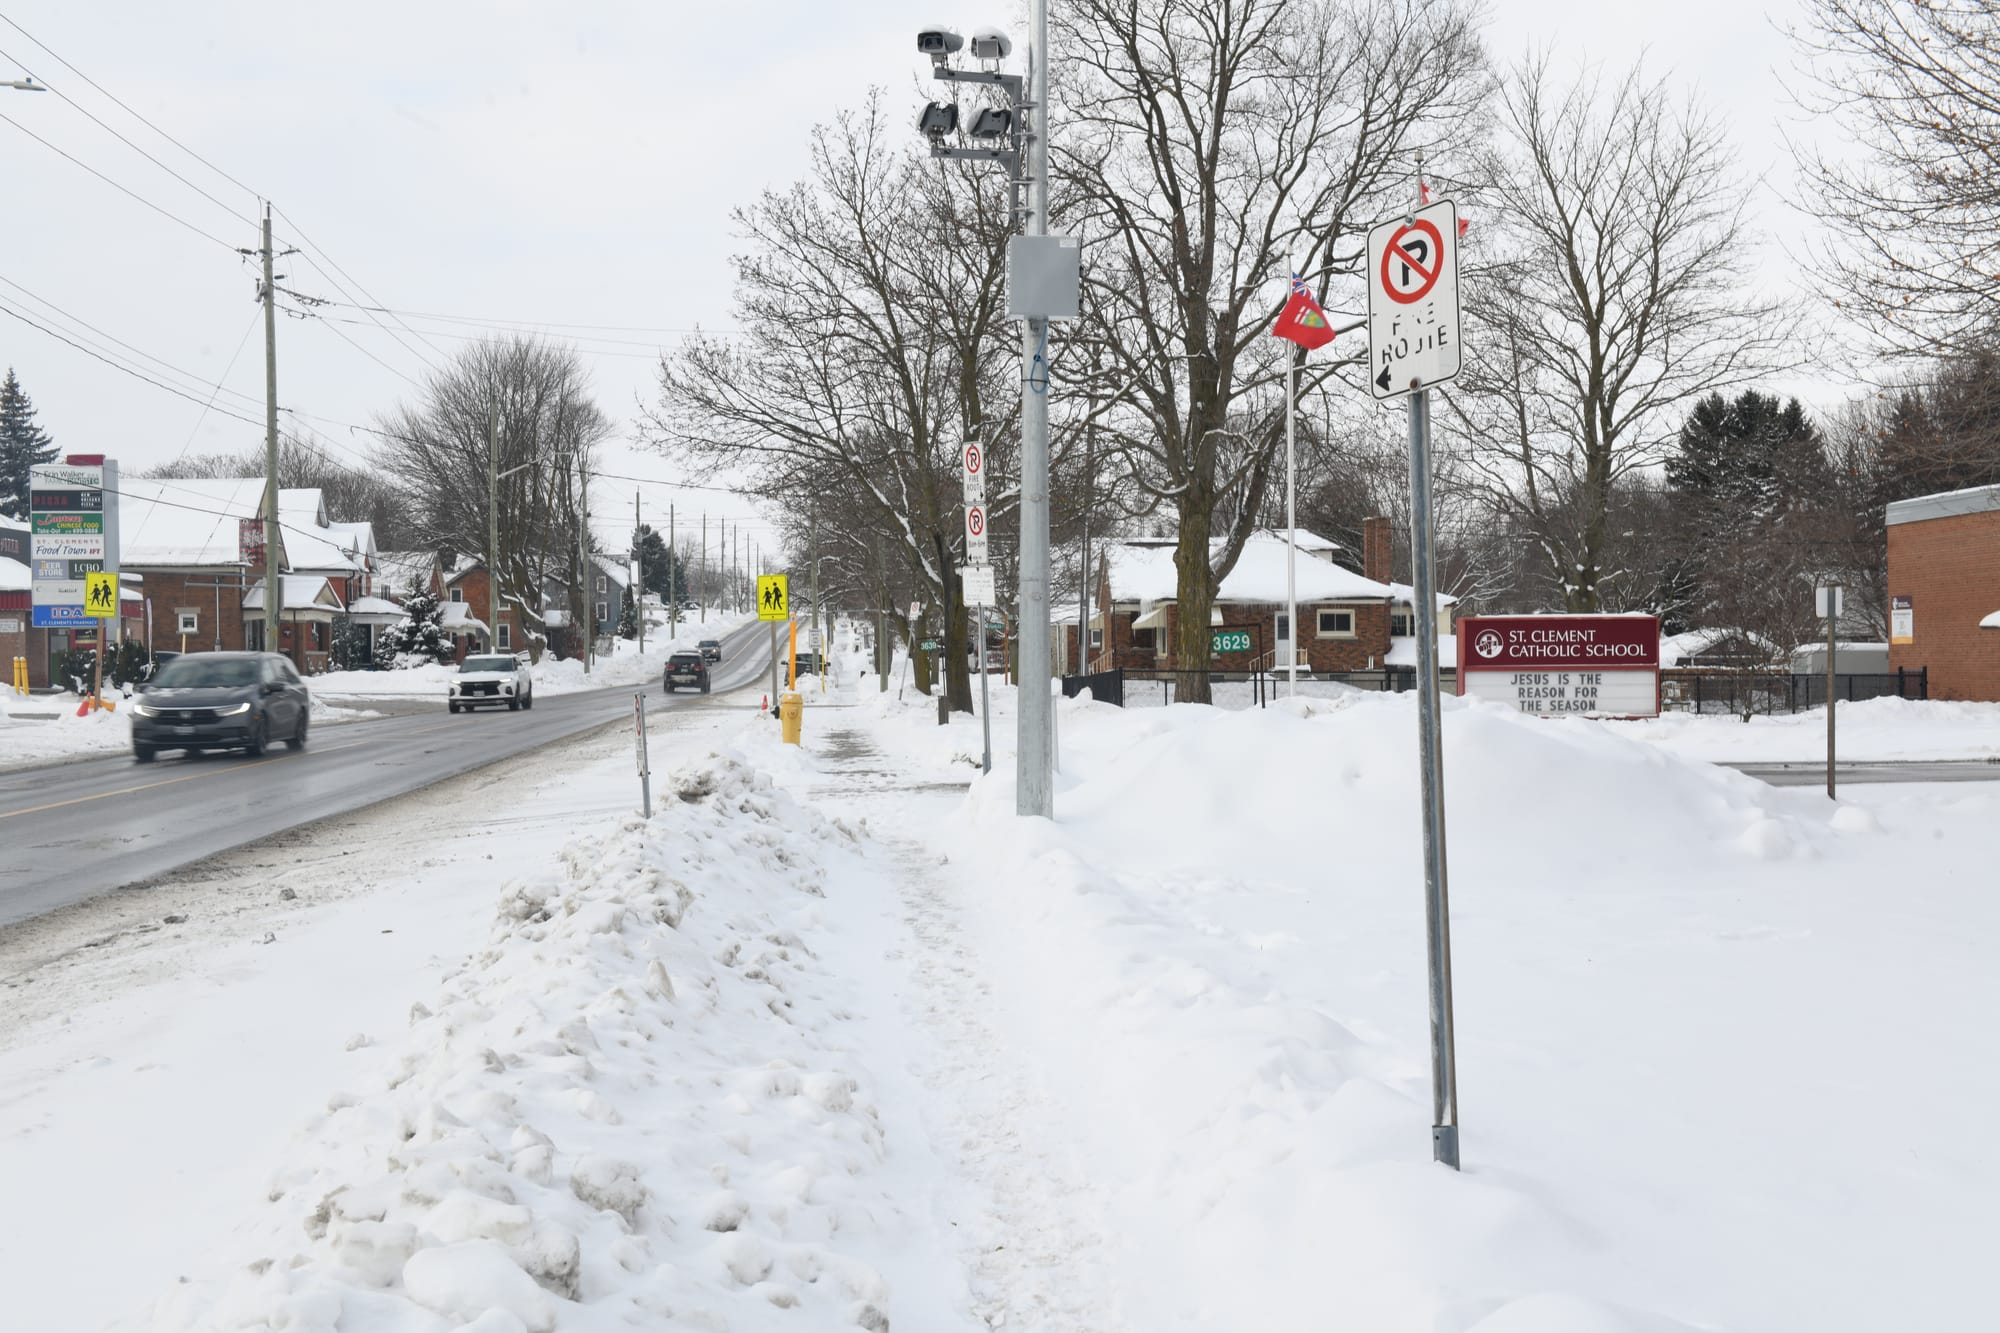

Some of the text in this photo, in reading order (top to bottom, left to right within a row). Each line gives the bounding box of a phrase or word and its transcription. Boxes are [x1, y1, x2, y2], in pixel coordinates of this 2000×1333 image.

[60, 470, 84, 478] Walker
[36, 544, 62, 555] Food
[64, 545, 86, 555] Town
[39, 568, 63, 576] STORE
[74, 563, 99, 573] LCBO
[1213, 634, 1250, 650] 3629
[1509, 630, 1596, 643] ST. CLEMENT
[920, 641, 937, 650] 3639
[1509, 644, 1647, 658] CATHOLIC SCHOOL
[1511, 674, 1602, 685] JESUS IS THE
[1518, 687, 1598, 698] REASON FOR
[1520, 700, 1596, 711] THE SEASON
